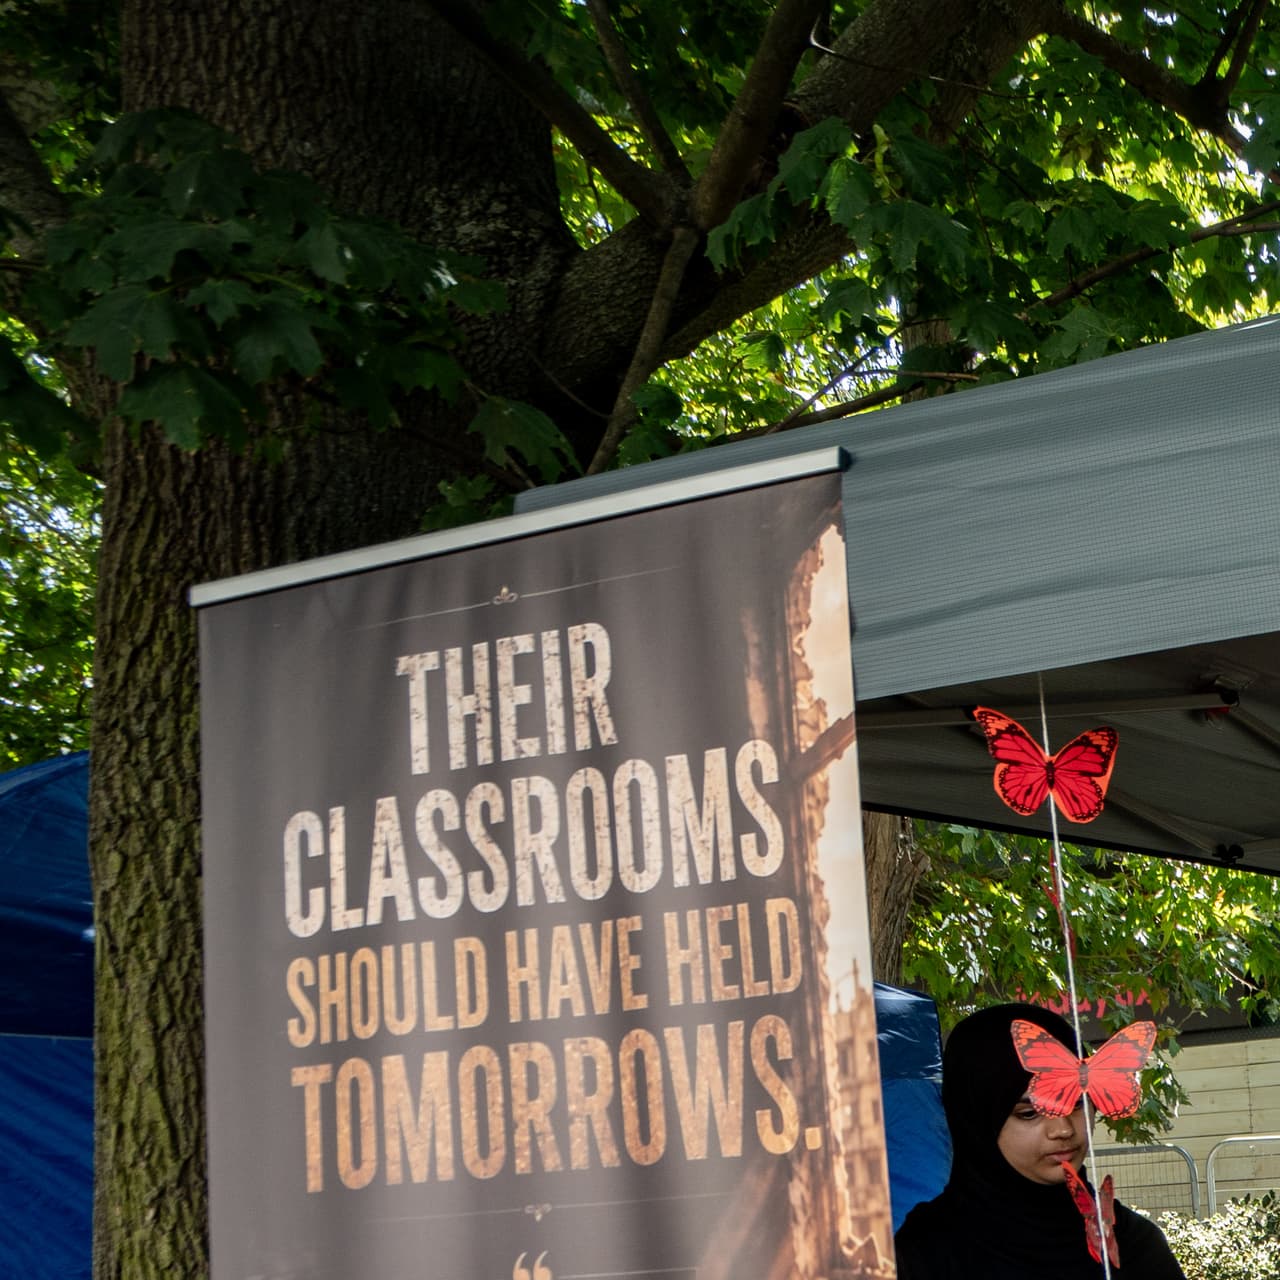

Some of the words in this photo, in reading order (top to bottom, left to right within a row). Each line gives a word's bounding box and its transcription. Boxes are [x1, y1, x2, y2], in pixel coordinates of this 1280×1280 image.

[396, 622, 618, 776] THEIR
[283, 738, 785, 938] CLASSROOMS
[286, 936, 489, 1048] SHOULD
[505, 915, 649, 1023] HAVE
[663, 896, 803, 1006] HELD
[291, 1014, 822, 1194] TOMORROWS.
